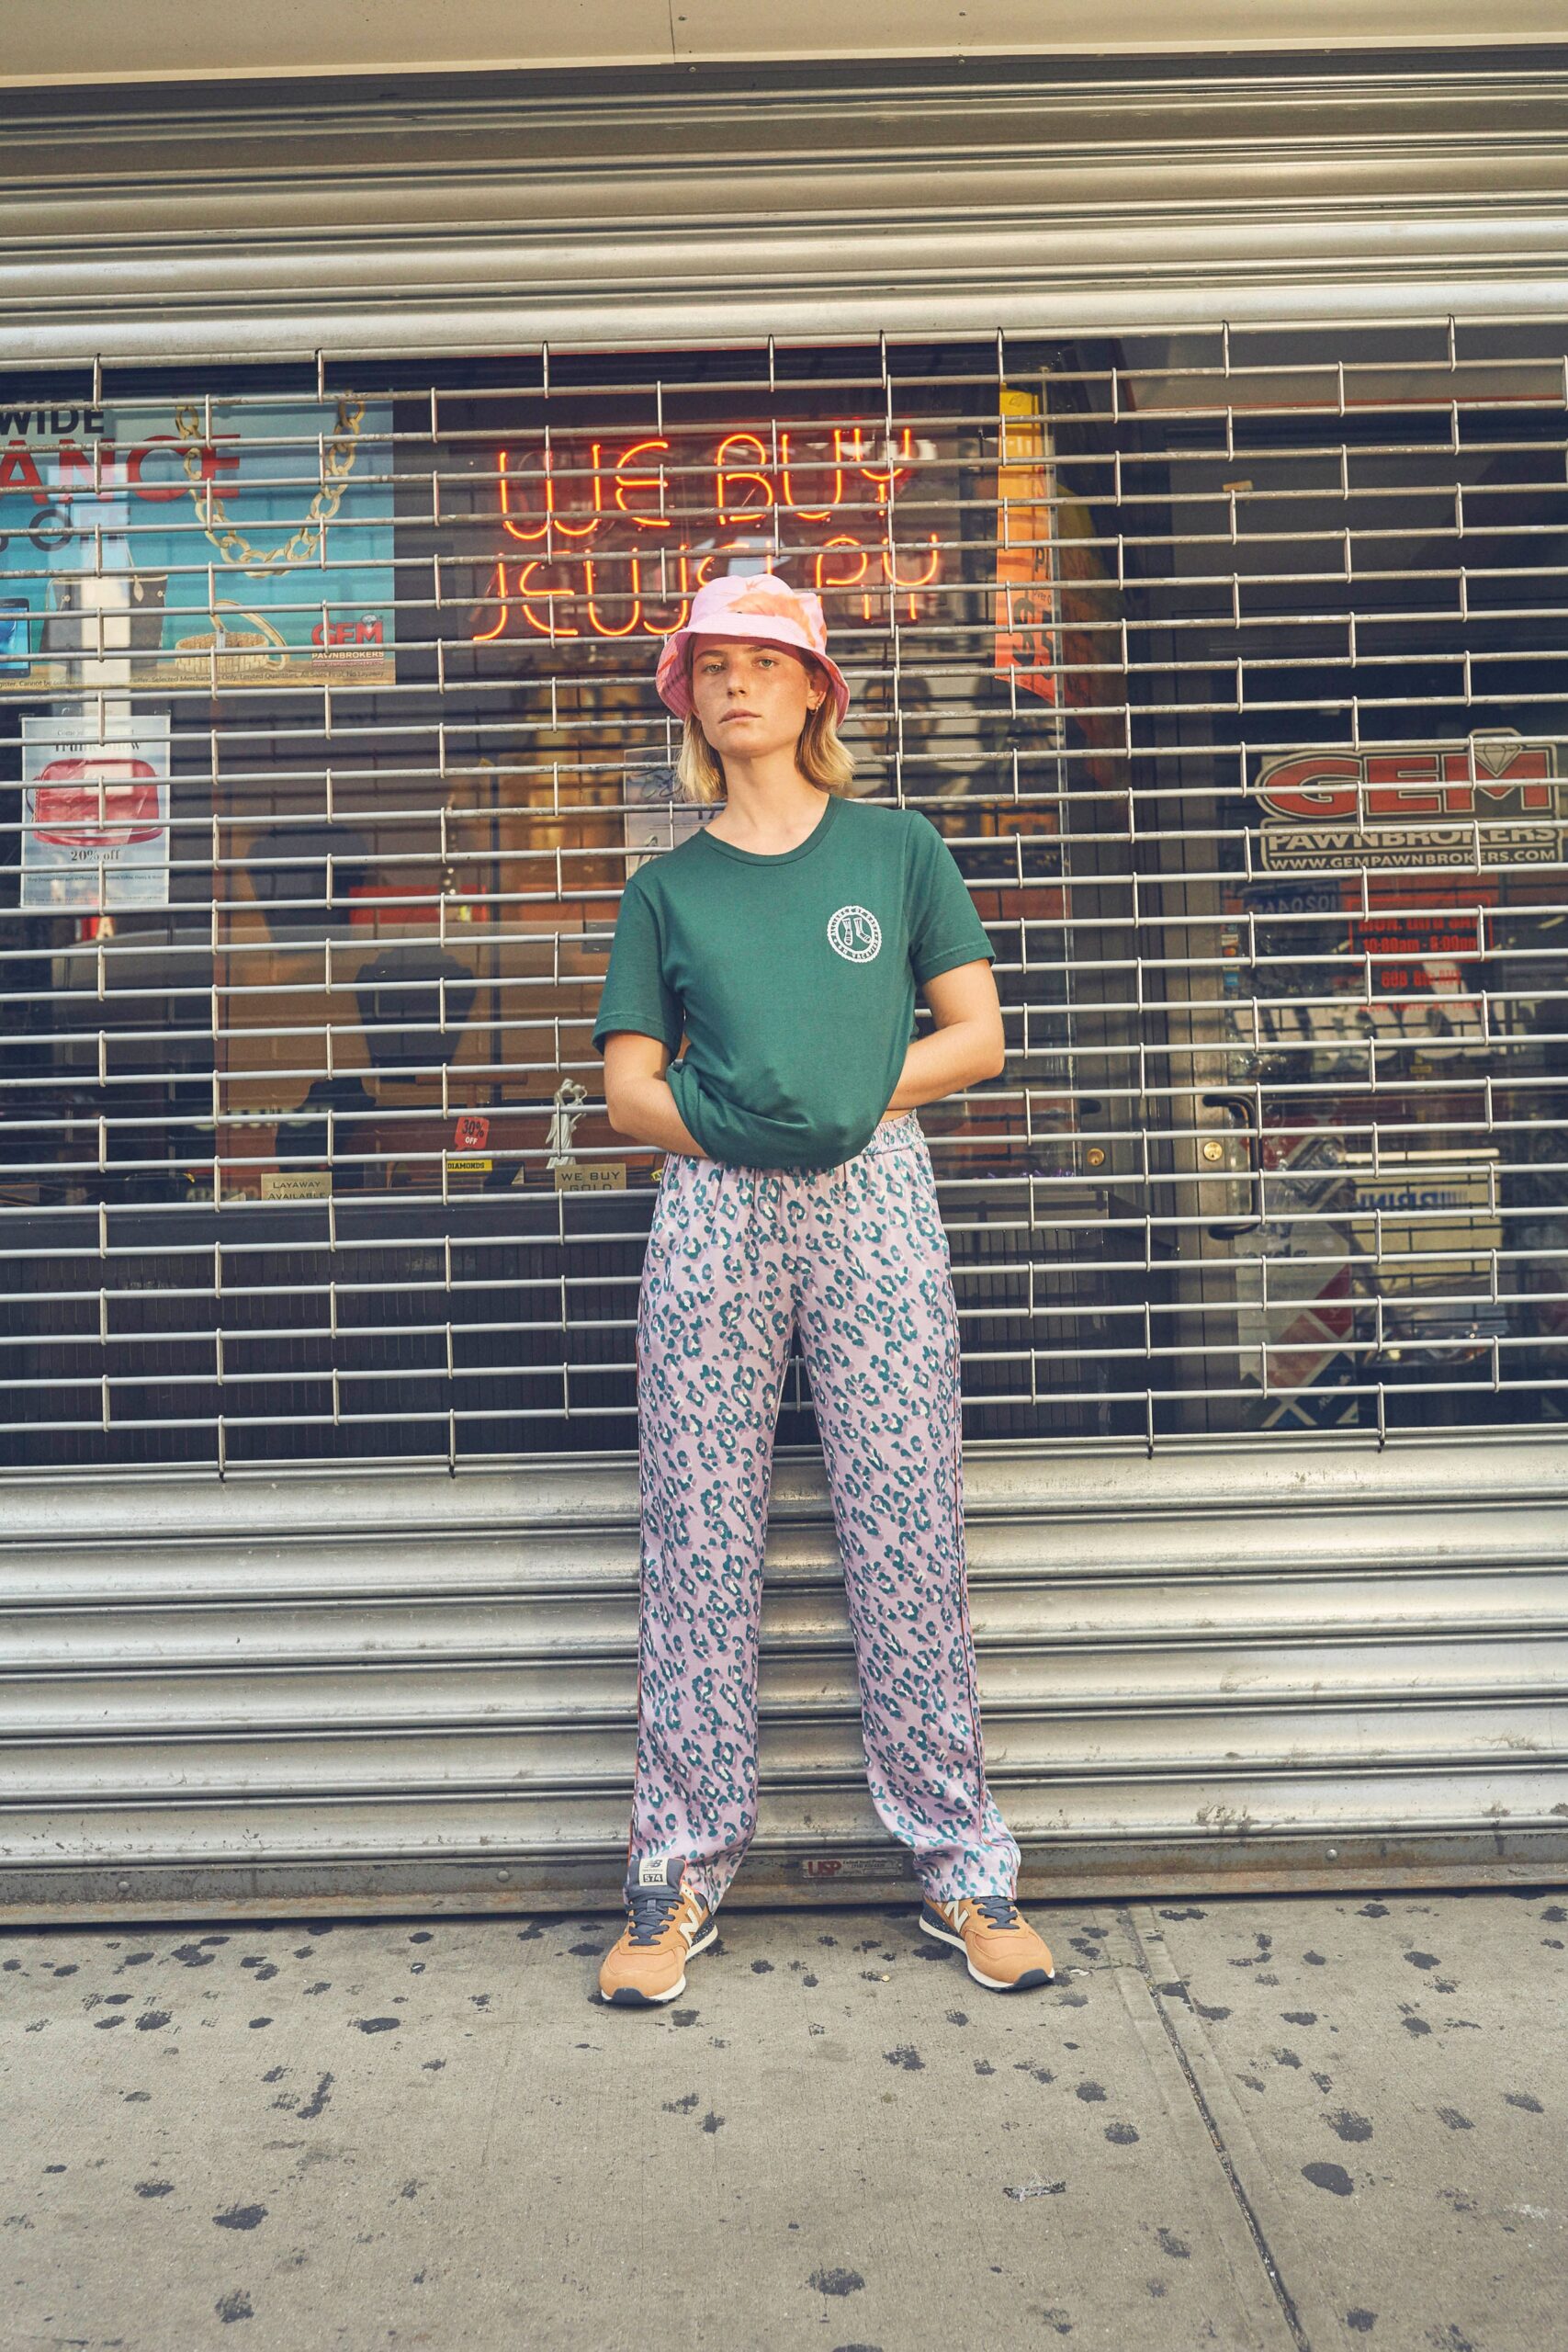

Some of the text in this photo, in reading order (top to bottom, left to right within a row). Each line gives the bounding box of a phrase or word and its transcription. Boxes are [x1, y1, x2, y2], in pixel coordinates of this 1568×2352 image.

[500, 427, 911, 540] WE BUY
[311, 620, 383, 646] GEM
[311, 650, 384, 660] PAWNBROKERS
[1260, 749, 1554, 819] GEM
[1268, 825, 1557, 851] PAWNBROKERS
[1269, 849, 1556, 870] WWW.GEMPAWNBROKERS.COM
[461, 1118, 485, 1138] 30%
[465, 1136, 479, 1145] OFF
[447, 1161, 485, 1170] DIAMONDS
[560, 1170, 621, 1182] WE BUY
[272, 1181, 321, 1189] LAYAWAY
[267, 1192, 326, 1200] AVAILABLE
[644, 1874, 662, 1883] 574
